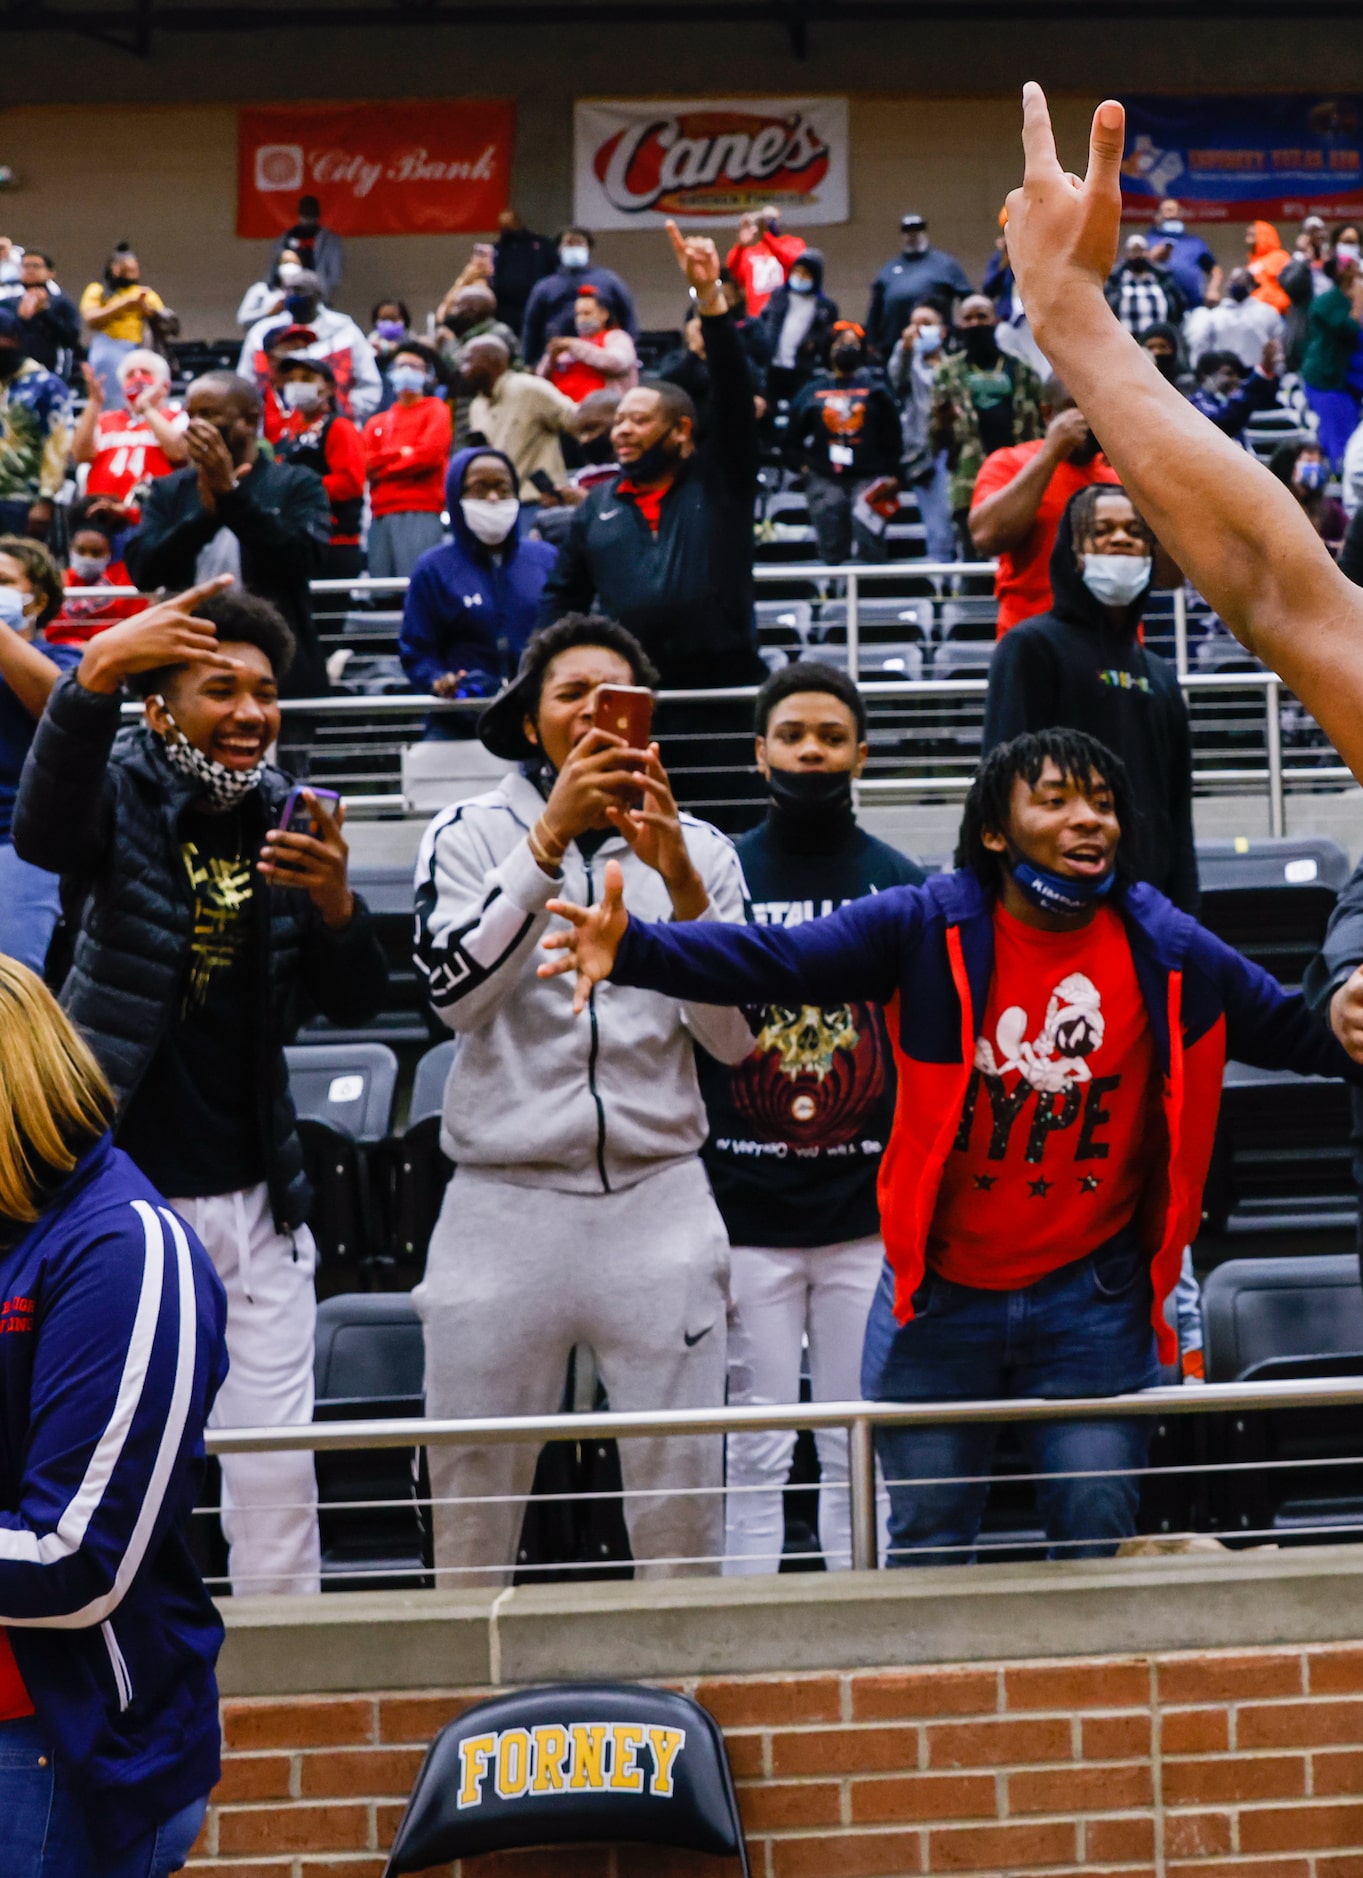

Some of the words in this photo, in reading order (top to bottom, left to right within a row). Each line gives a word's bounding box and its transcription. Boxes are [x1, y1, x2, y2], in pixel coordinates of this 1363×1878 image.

[309, 151, 383, 197] City
[386, 145, 497, 182] Bank
[602, 113, 829, 212] Cane's
[457, 1722, 687, 1810] FORNEY
